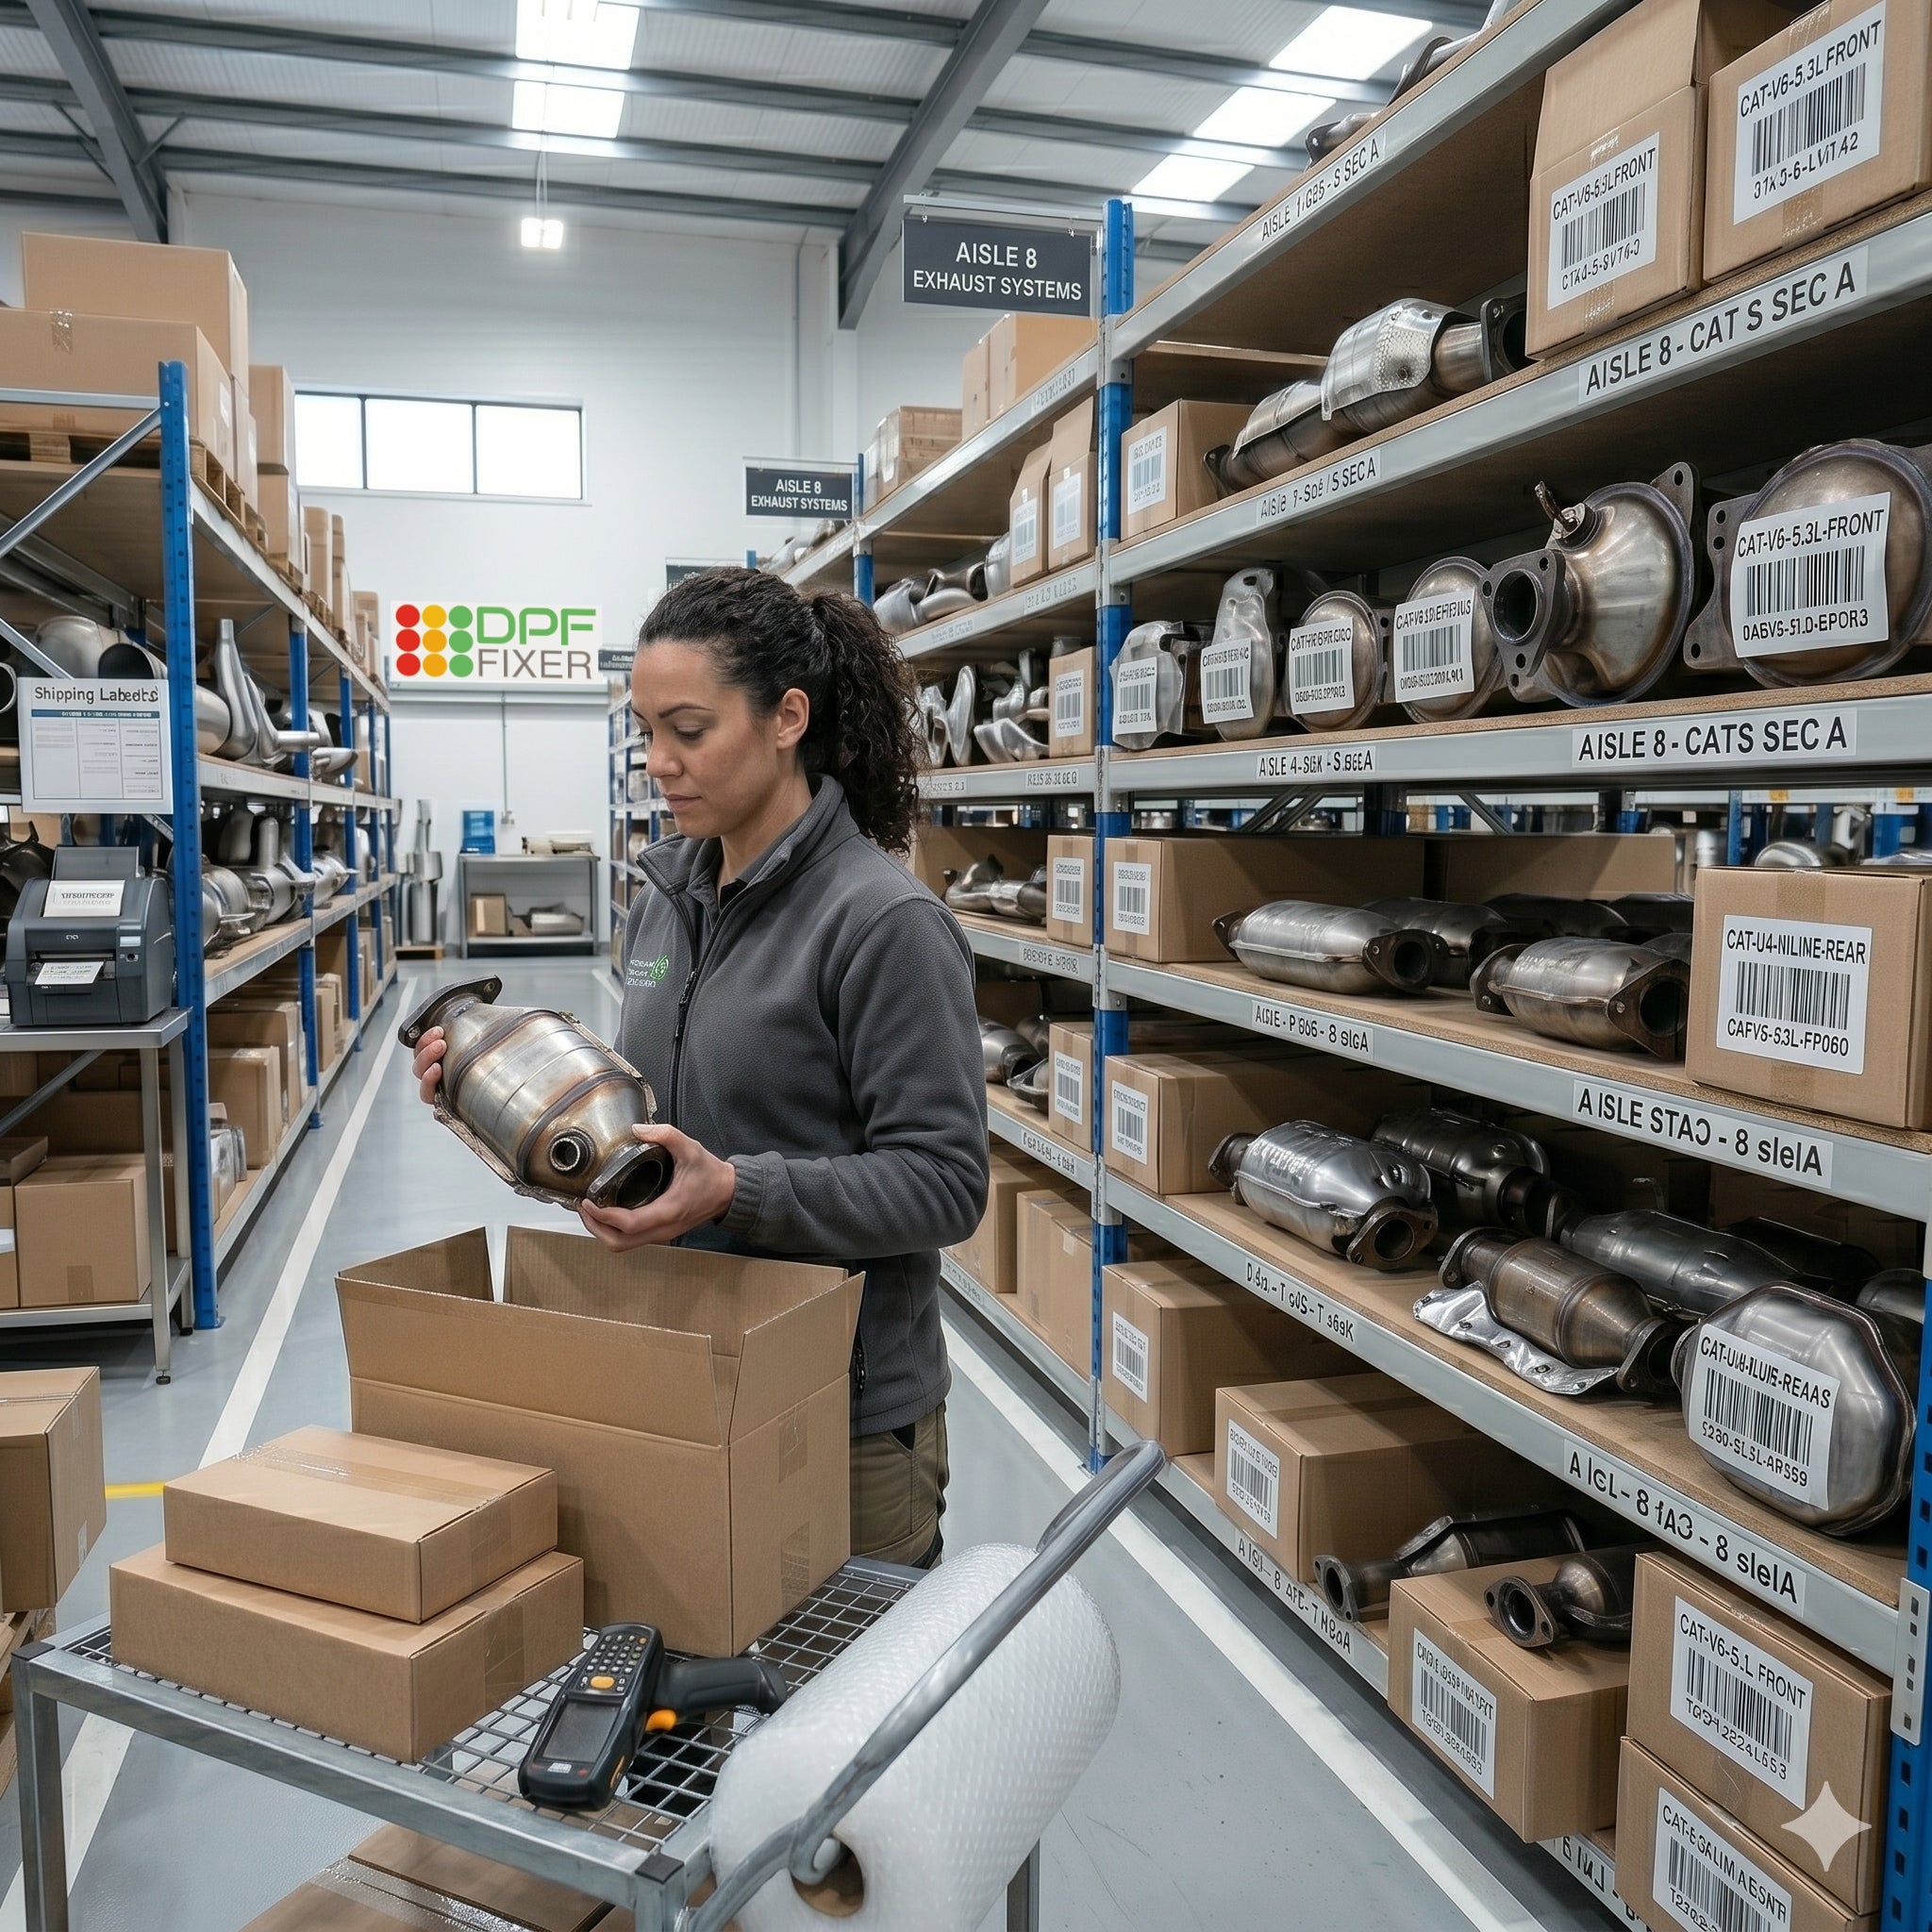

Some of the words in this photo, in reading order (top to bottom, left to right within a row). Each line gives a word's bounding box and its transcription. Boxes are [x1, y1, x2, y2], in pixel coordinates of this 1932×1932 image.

[1262, 205, 1291, 241] AISLE
[1344, 146, 1366, 182] SEC
[1370, 138, 1379, 162] A
[956, 242, 1019, 267] AISLE
[1025, 248, 1038, 269] 8
[913, 270, 996, 293] EXHAUST
[1000, 277, 1082, 301] SYSTEMS
[1586, 341, 1652, 395] AISLE
[1658, 335, 1672, 366] 8
[1772, 272, 1827, 322] SEC
[1835, 261, 1856, 299] A
[775, 478, 811, 493] AISLE
[814, 481, 822, 494] 8
[751, 495, 798, 508] EXHAUST
[800, 497, 848, 511] SYSTEMS
[476, 606, 596, 645] DPF
[478, 648, 592, 680] FIXER
[35, 687, 94, 705] Shipping
[1577, 731, 1646, 761] AISLE
[1653, 729, 1666, 758] 8
[1685, 723, 1755, 756] CATS
[1762, 718, 1820, 752] SEC
[1825, 716, 1847, 750] A
[1328, 1024, 1337, 1043] 8
[1578, 1088, 1643, 1129] AISLE
[1734, 1128, 1749, 1157] 8
[1715, 1534, 1728, 1562] 8
[1274, 1570, 1281, 1590] 8
[1757, 1663, 1807, 1709] FRONT
